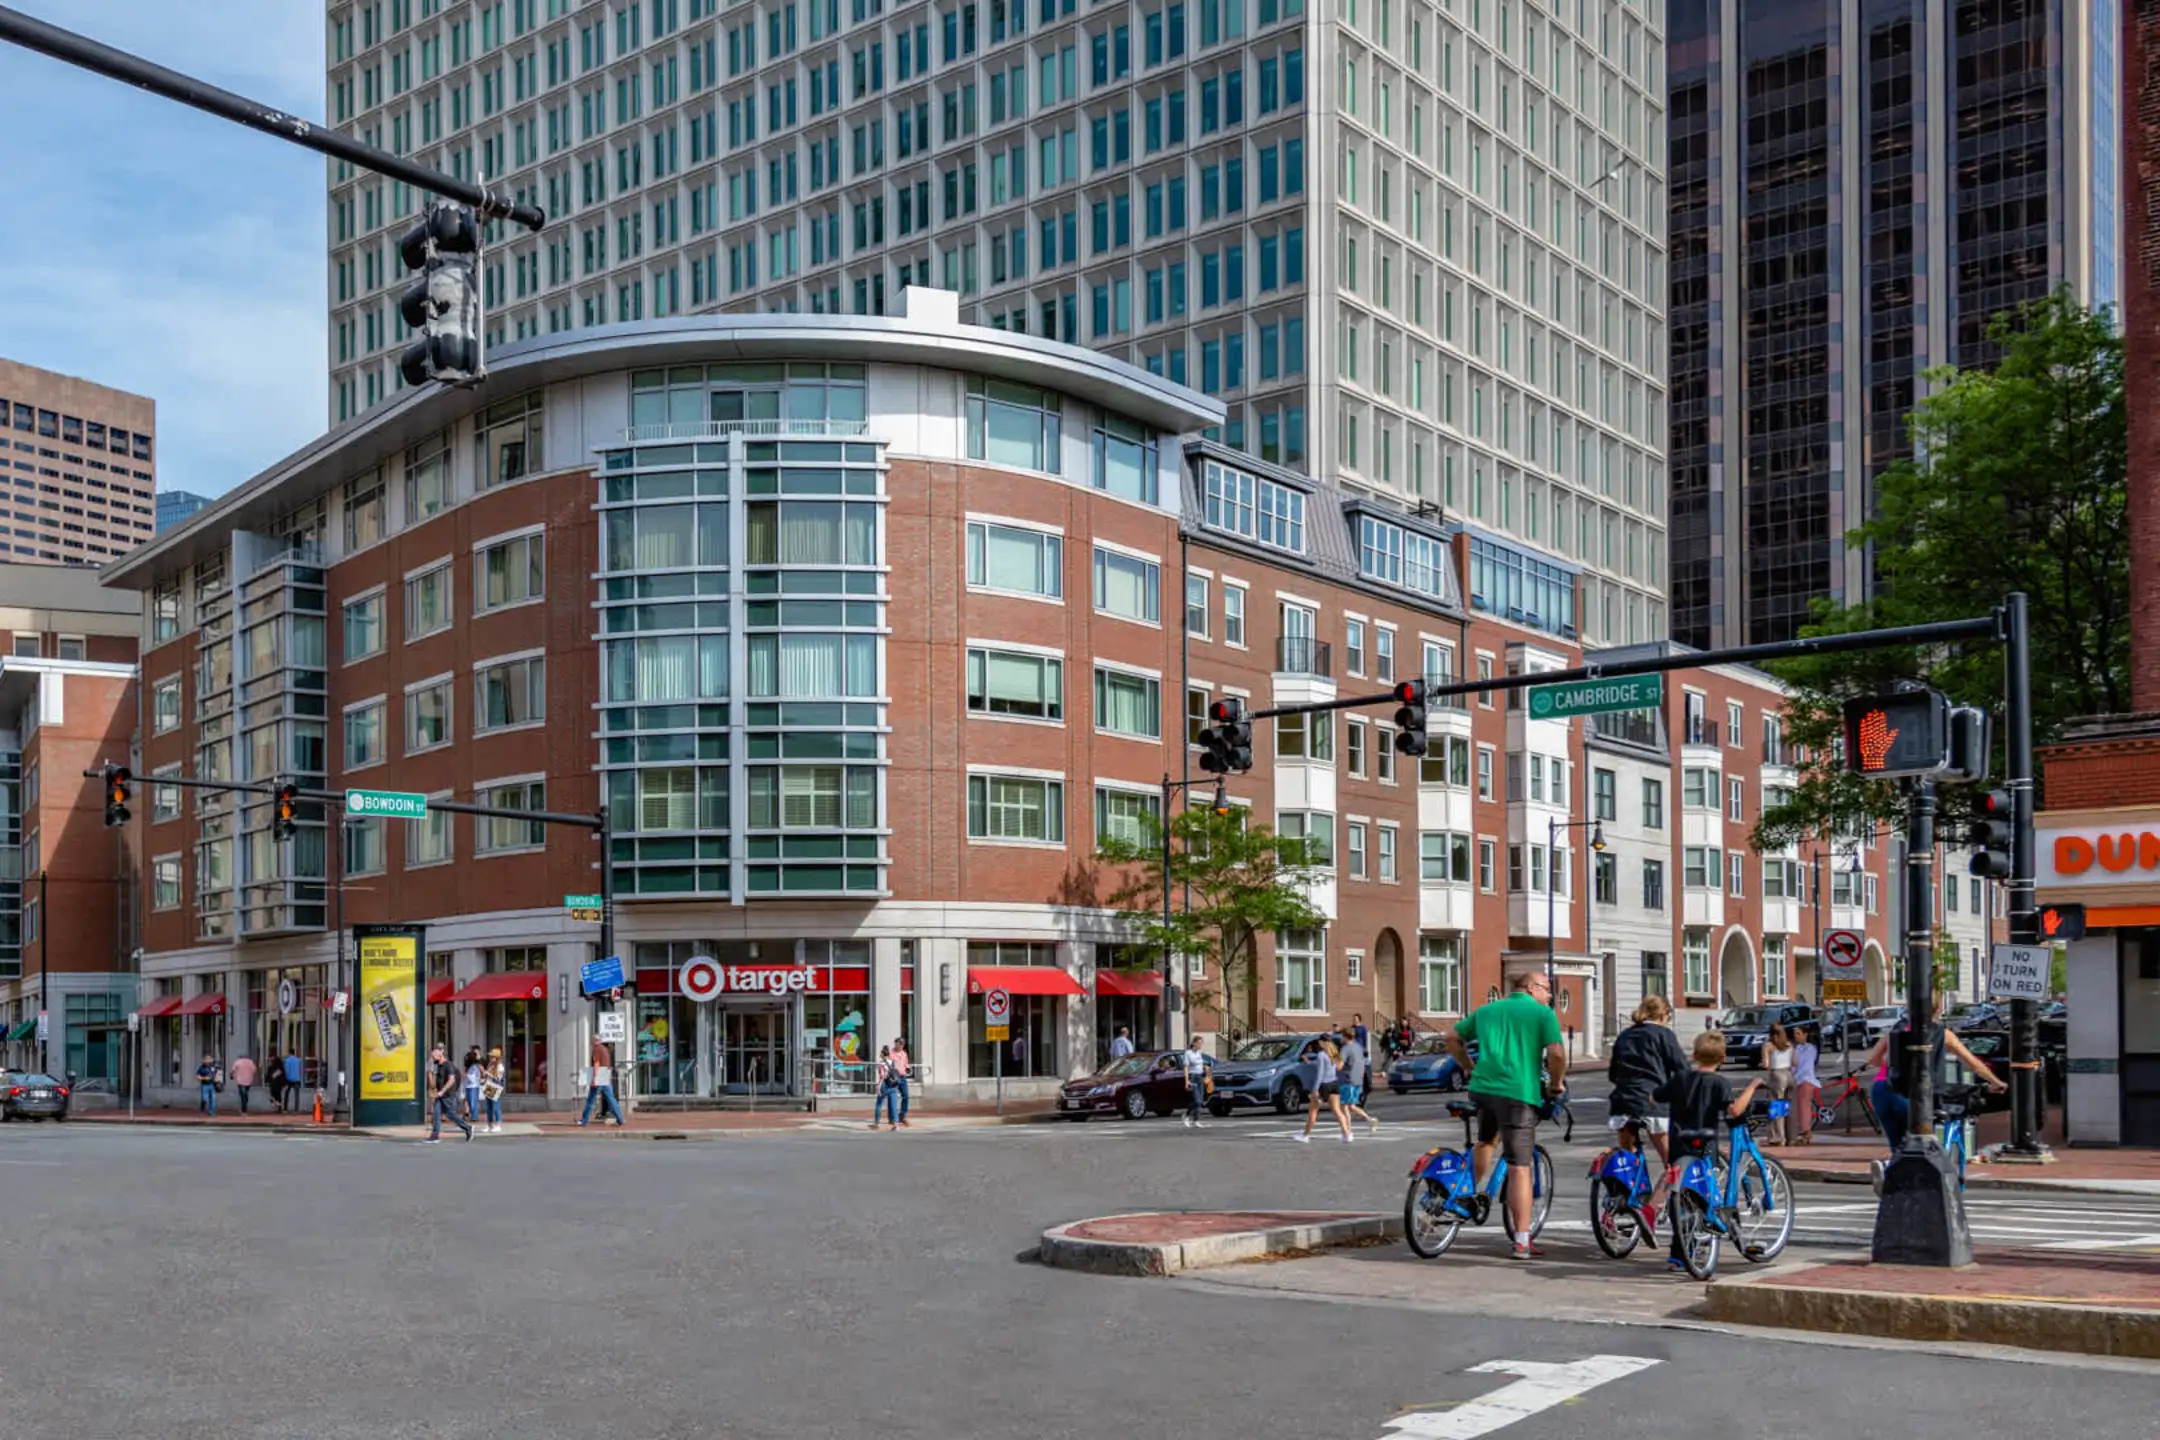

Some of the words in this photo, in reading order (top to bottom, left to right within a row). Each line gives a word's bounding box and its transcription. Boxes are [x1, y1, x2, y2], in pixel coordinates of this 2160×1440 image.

[1555, 684, 1640, 710] CAMBRIDGE
[1646, 687, 1658, 699] ST
[364, 796, 415, 812] BOWDOIN
[2012, 951, 2030, 962] NO
[2003, 965, 2037, 977] TURN
[727, 965, 817, 996] target
[1993, 979, 2011, 990] ON
[2016, 981, 2042, 992] RED
